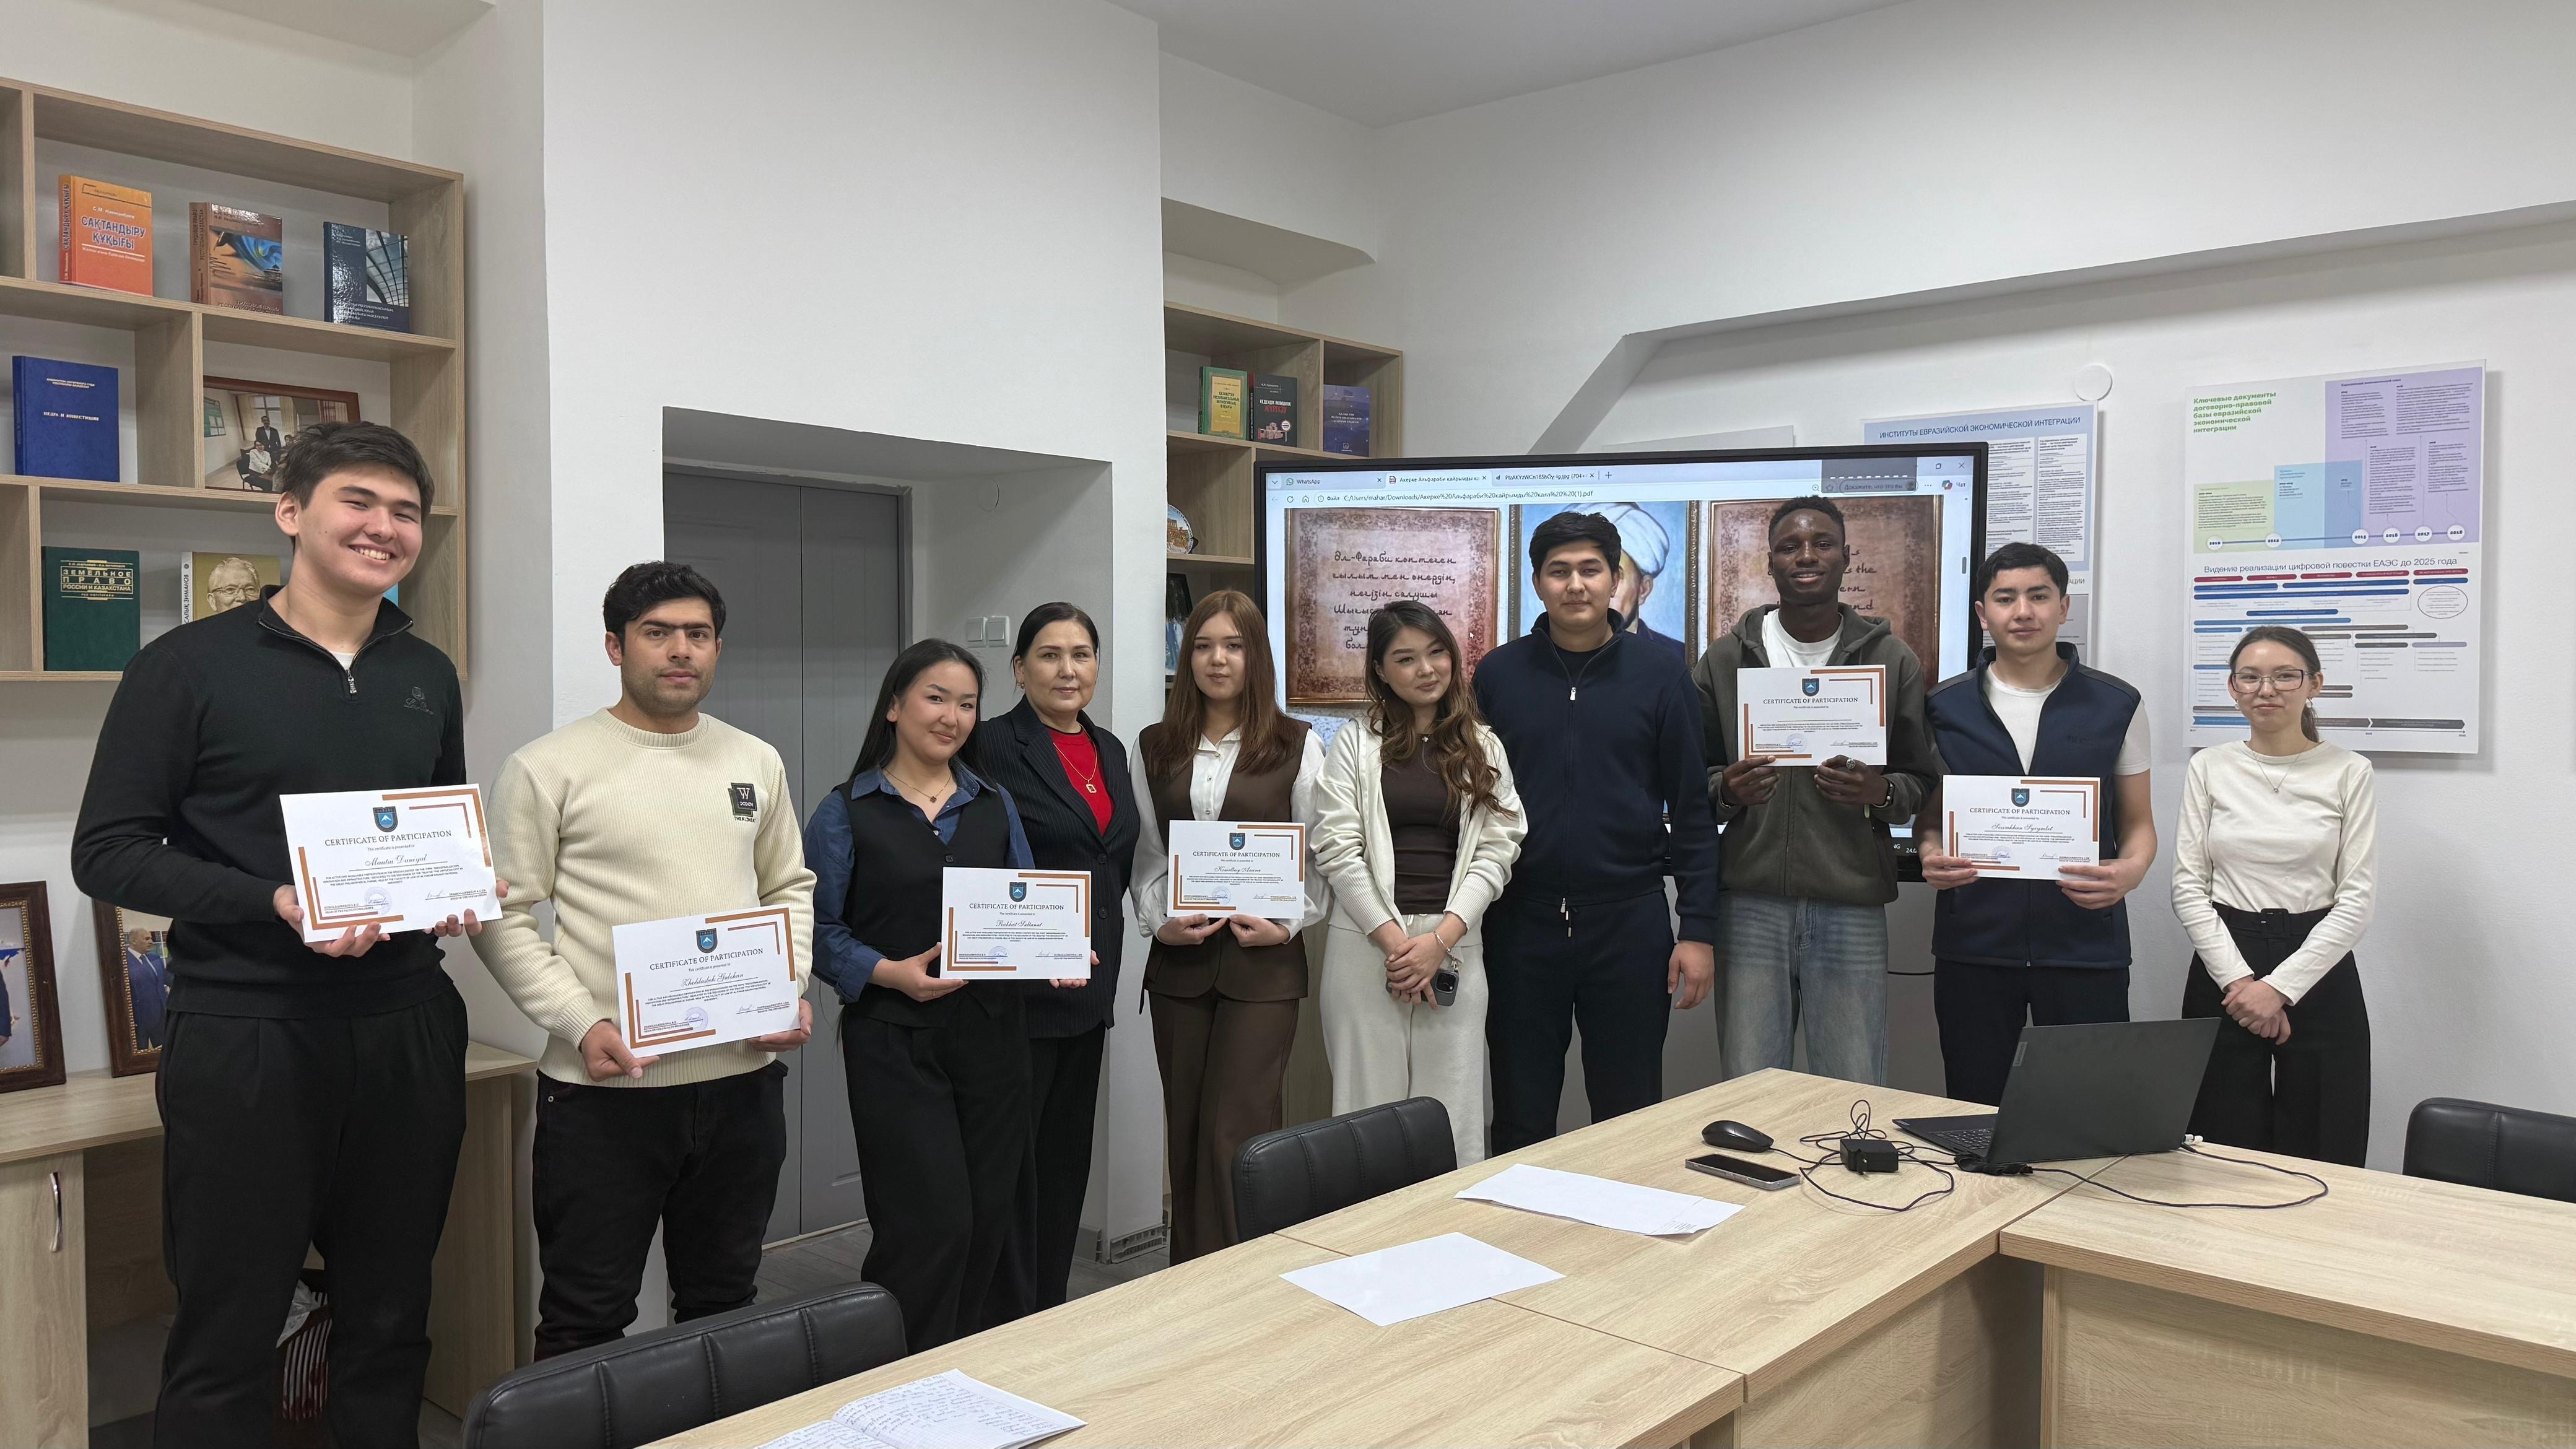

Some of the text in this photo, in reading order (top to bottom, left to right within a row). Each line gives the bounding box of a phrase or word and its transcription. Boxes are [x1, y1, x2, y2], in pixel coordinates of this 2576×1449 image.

[81, 215, 146, 238] САҚТАНДЫРУ
[92, 232, 134, 249] ҚҰҚЫҒЫ
[2193, 392, 2276, 404] Ключевые документы
[2193, 399, 2272, 412] договорно-правовой
[2213, 408, 2261, 417] евразийской
[2193, 416, 2251, 426] экономической
[1880, 417, 2081, 438] ИНСТИТУТЫ ЕВРАЗИЙСКОЙ ЭКОНОМИЧЕСКОЙ ИНТЕГРАЦИИ
[2193, 425, 2237, 433] интеграции
[1856, 563, 1878, 573] the
[2240, 564, 2287, 573] реализации
[2289, 562, 2331, 571] цифровой
[2414, 558, 2435, 566] 2025
[63, 569, 131, 577] ЗЕМЕЛЬНОЕ
[63, 577, 131, 585] ПРАВО
[324, 836, 376, 846] CERTIFICATE
[391, 830, 452, 842] PARTICIPATION
[650, 957, 697, 970] CERTIFICATE
[710, 948, 764, 961] PARTICIPATION
